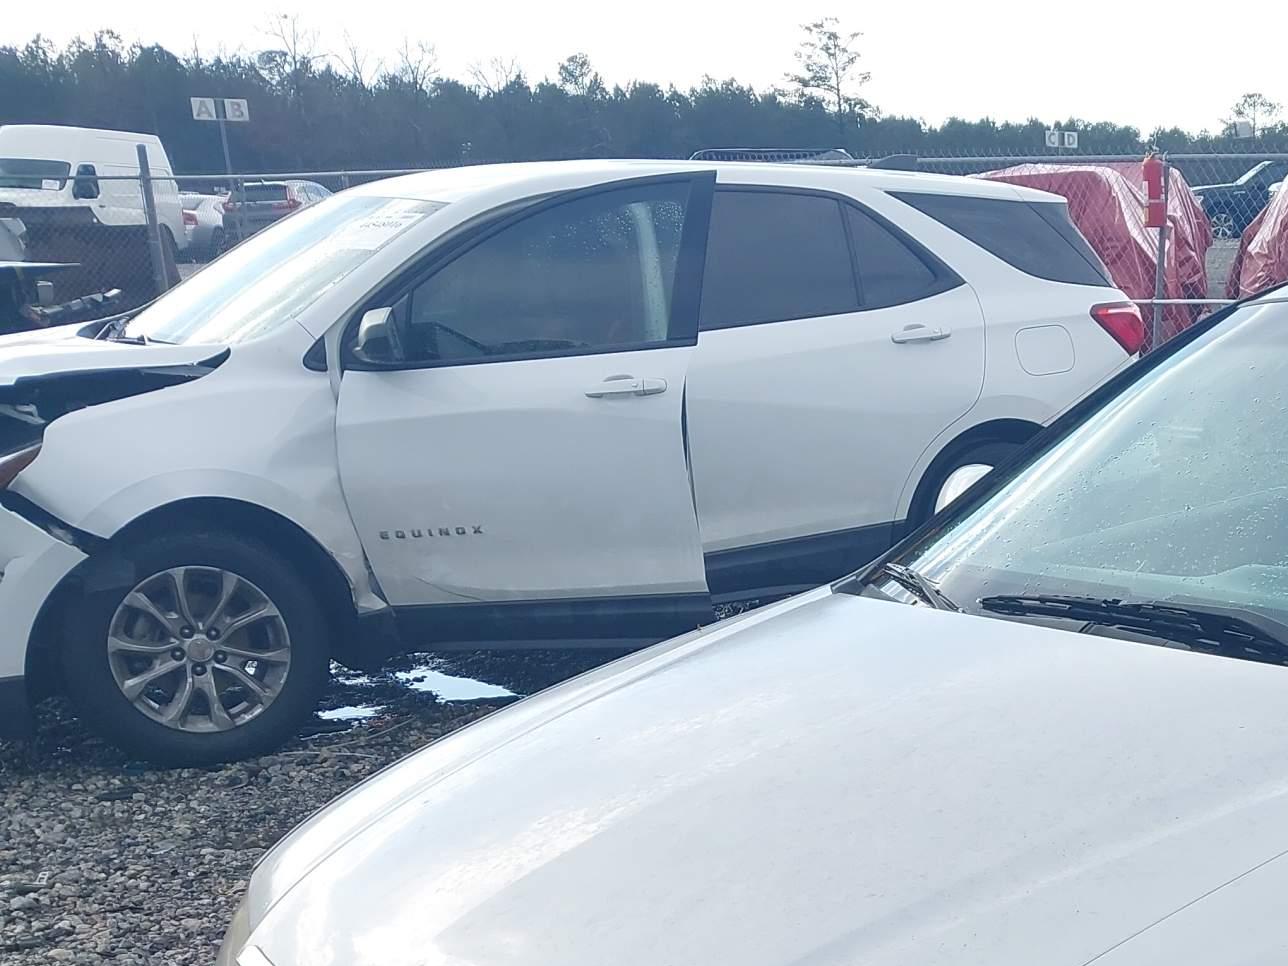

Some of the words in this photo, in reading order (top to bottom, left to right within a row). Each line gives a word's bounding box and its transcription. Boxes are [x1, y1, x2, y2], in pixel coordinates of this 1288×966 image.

[195, 100, 214, 117] A
[230, 101, 244, 118] B
[1048, 132, 1057, 145] C
[1067, 133, 1076, 146] D
[379, 525, 483, 540] EQUINOX
